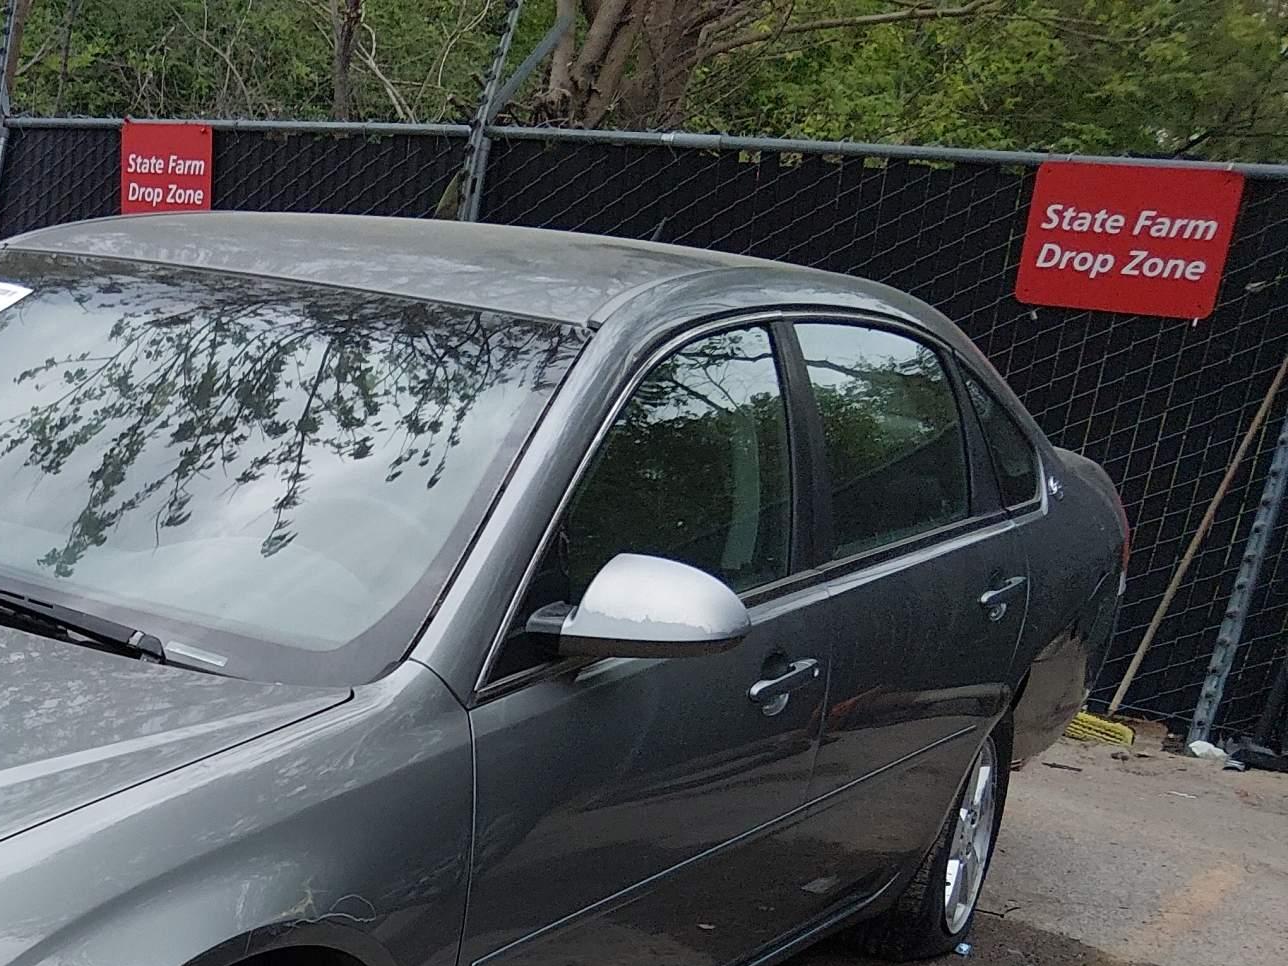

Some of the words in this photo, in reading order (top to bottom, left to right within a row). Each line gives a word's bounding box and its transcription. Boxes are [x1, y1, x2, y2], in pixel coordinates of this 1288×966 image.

[128, 153, 164, 174] State
[167, 155, 205, 176] Farm
[128, 182, 163, 207] Drop
[166, 184, 204, 205] Zone
[1040, 204, 1125, 234] State
[1132, 210, 1218, 241] Farm
[1035, 243, 1115, 279] Drop
[1120, 250, 1207, 281] Zone
